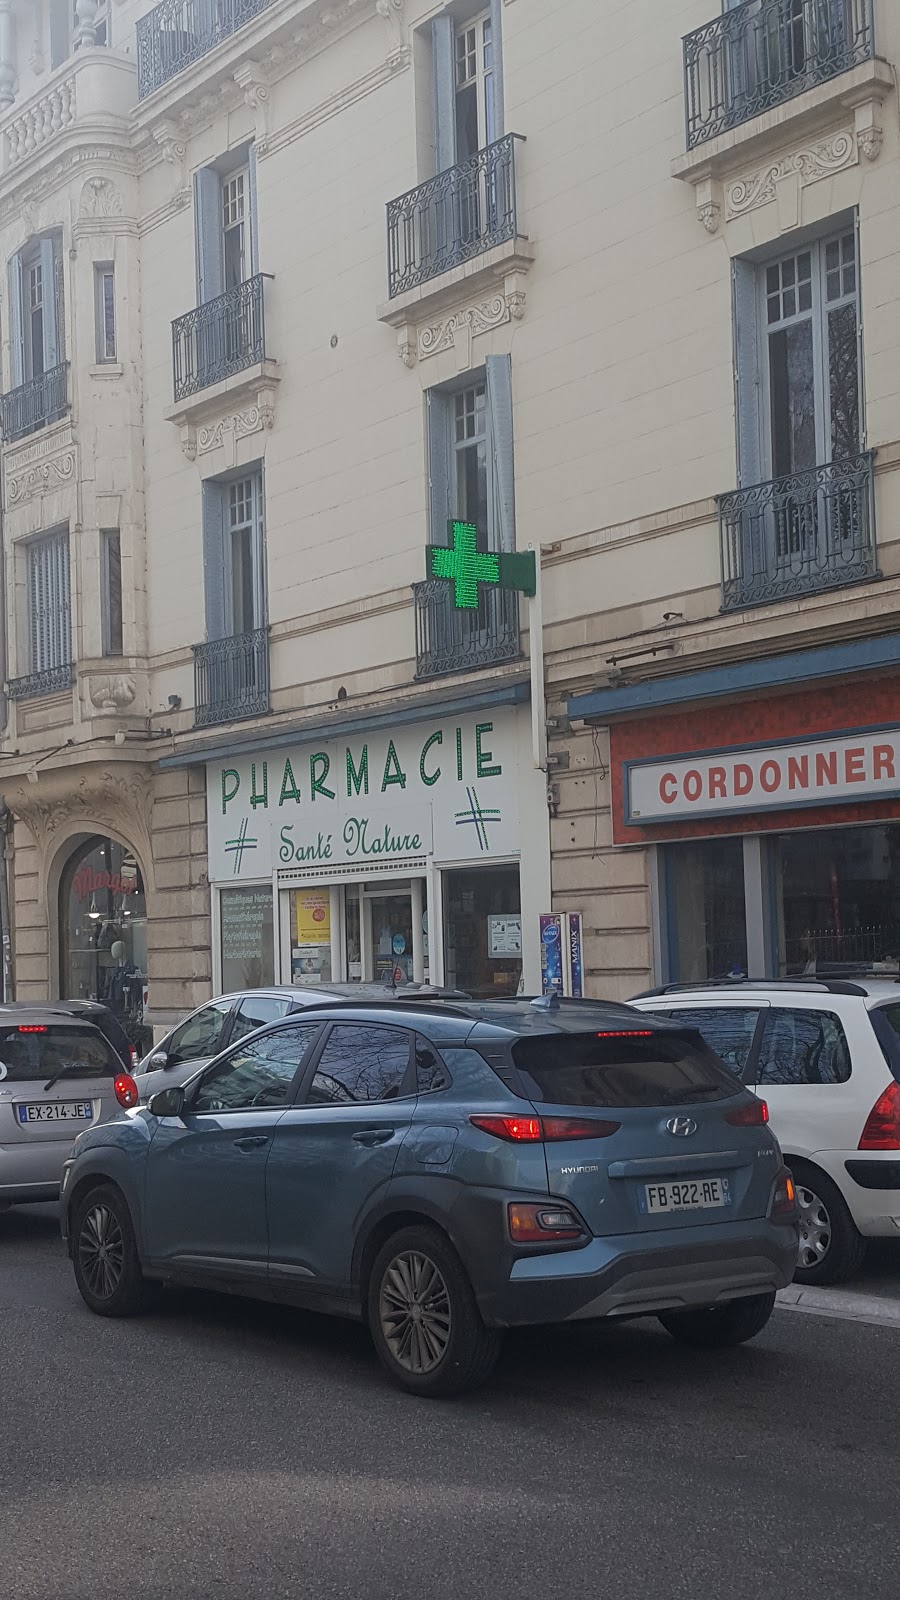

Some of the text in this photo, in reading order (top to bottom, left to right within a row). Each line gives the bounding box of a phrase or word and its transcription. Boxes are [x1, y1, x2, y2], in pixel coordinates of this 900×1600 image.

[221, 721, 502, 815] PHARMACIE
[658, 743, 896, 804] CORDONNER
[278, 817, 423, 862] Santé Nature
[571, 929, 579, 963] MANIX
[28, 1104, 85, 1120] EX-214-JE
[561, 1165, 599, 1174] HYUNDAI
[648, 1181, 720, 1207] FB-922-RE
